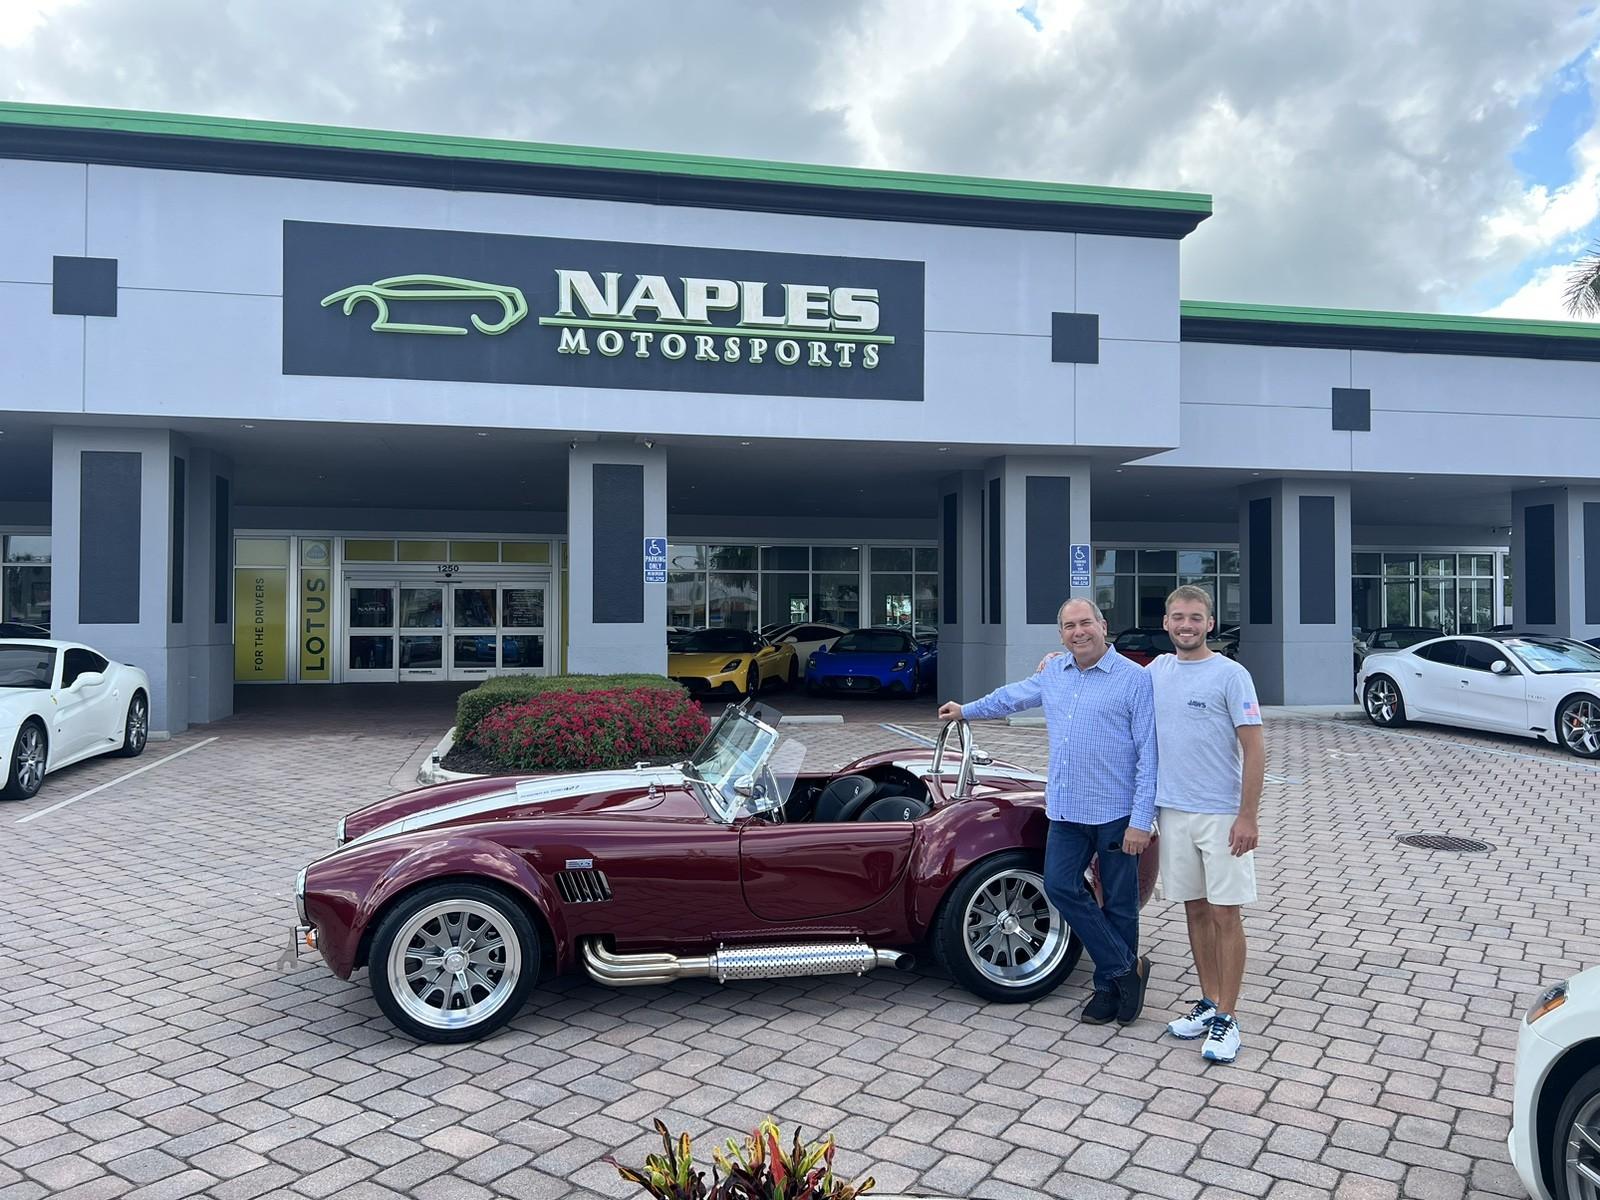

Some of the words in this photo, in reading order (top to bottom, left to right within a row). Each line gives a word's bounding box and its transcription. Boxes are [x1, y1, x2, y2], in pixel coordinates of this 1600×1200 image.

[554, 269, 880, 333] NAPLES
[557, 327, 880, 369] MOTORSPORTS
[255, 578, 264, 624] DRIVERS
[255, 627, 264, 647] THE
[306, 578, 325, 671] LOTUS
[255, 650, 264, 671] FOR
